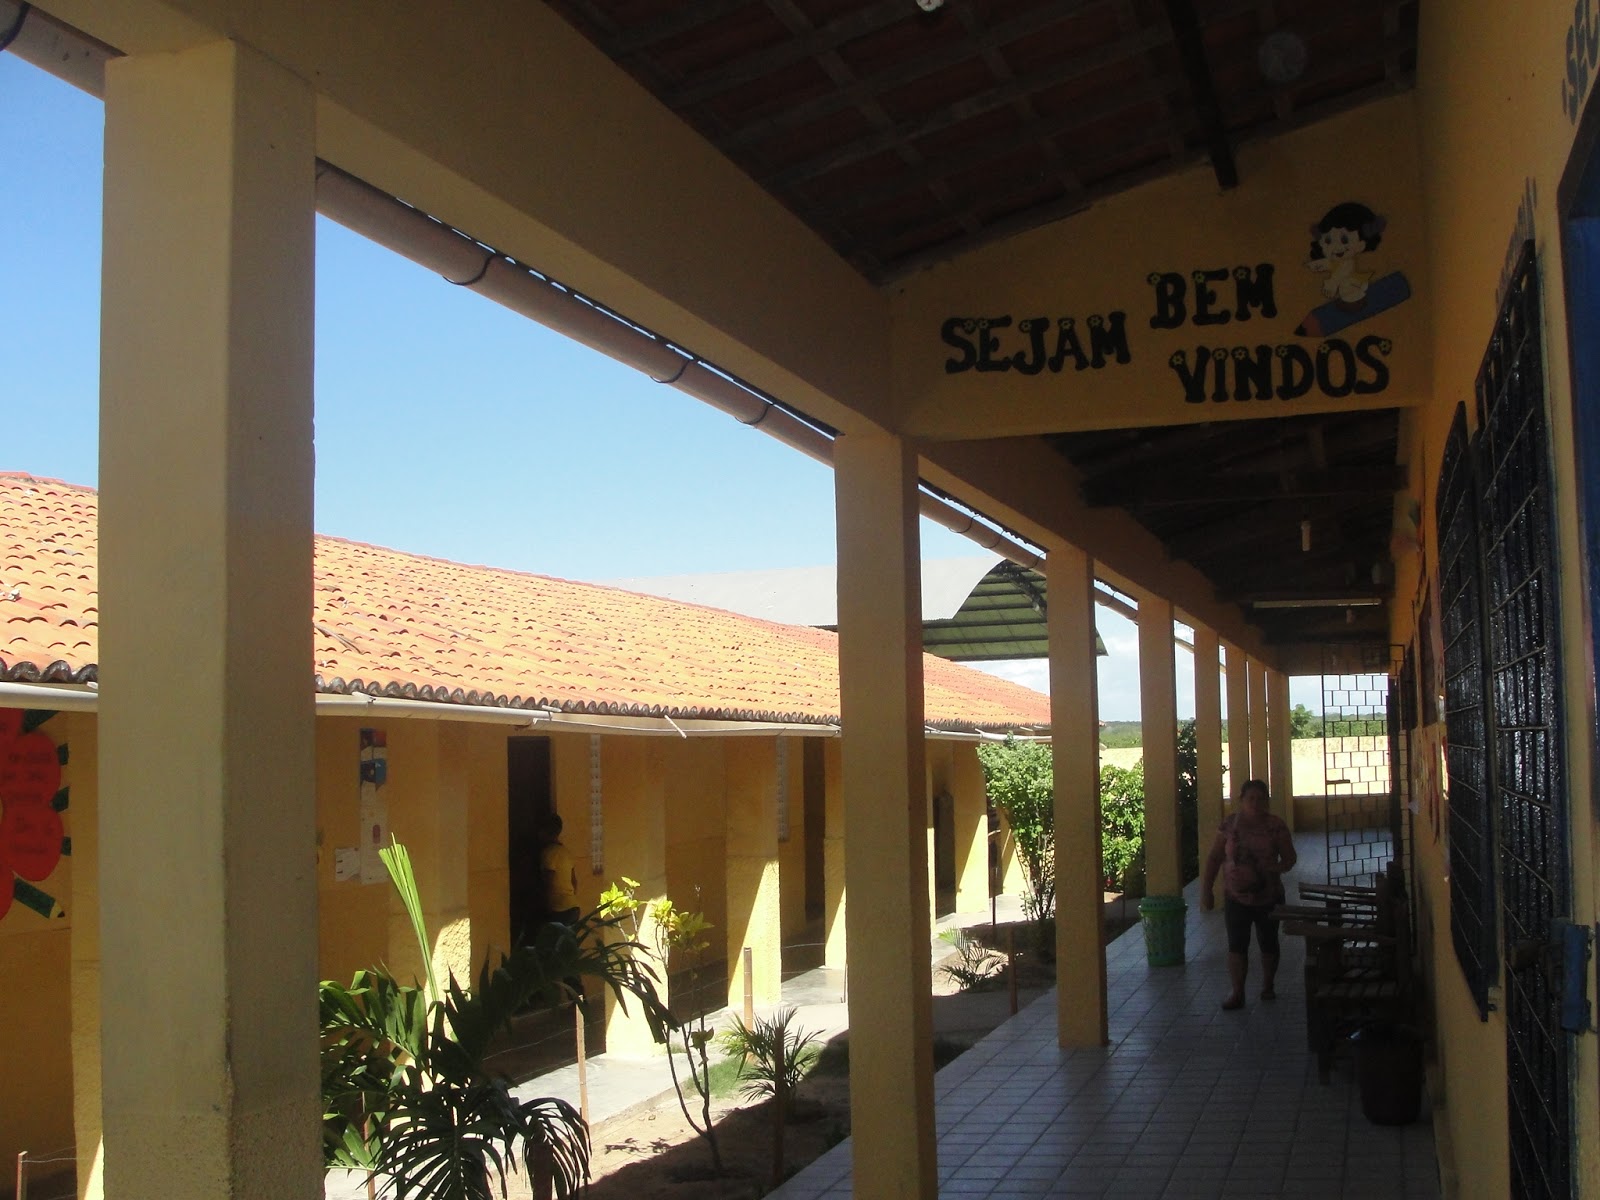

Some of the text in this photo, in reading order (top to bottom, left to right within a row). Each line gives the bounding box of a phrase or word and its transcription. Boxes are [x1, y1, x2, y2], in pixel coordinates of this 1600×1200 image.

[1146, 262, 1278, 329] BEM
[939, 310, 1131, 375] SEJAM
[1168, 334, 1392, 403] VINDOS
